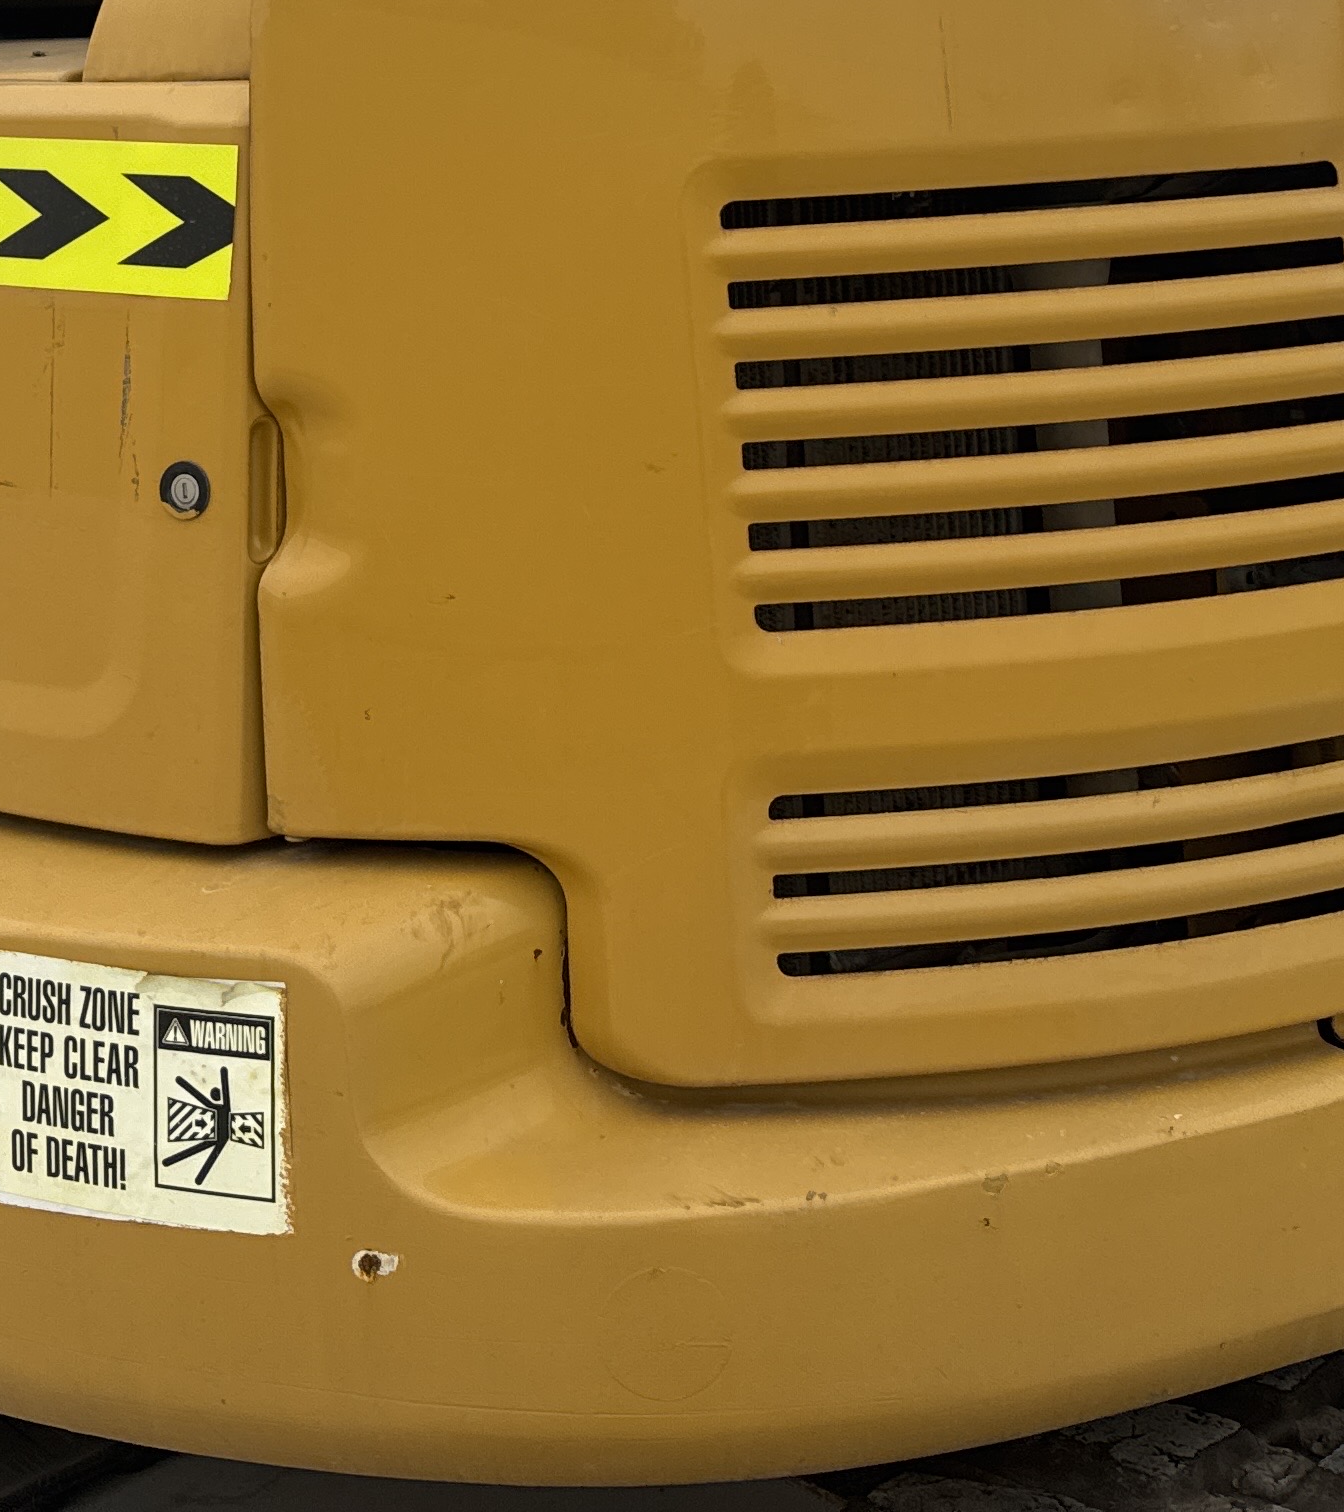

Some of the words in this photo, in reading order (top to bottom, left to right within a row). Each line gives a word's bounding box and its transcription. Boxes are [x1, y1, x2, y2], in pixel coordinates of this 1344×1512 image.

[79, 985, 140, 1036] ZONE
[189, 1019, 266, 1055] WARNING
[63, 1035, 139, 1089] CLEAR
[22, 1079, 115, 1137] DANGER
[11, 1128, 39, 1174] OF
[46, 1135, 127, 1191] DEATH!
